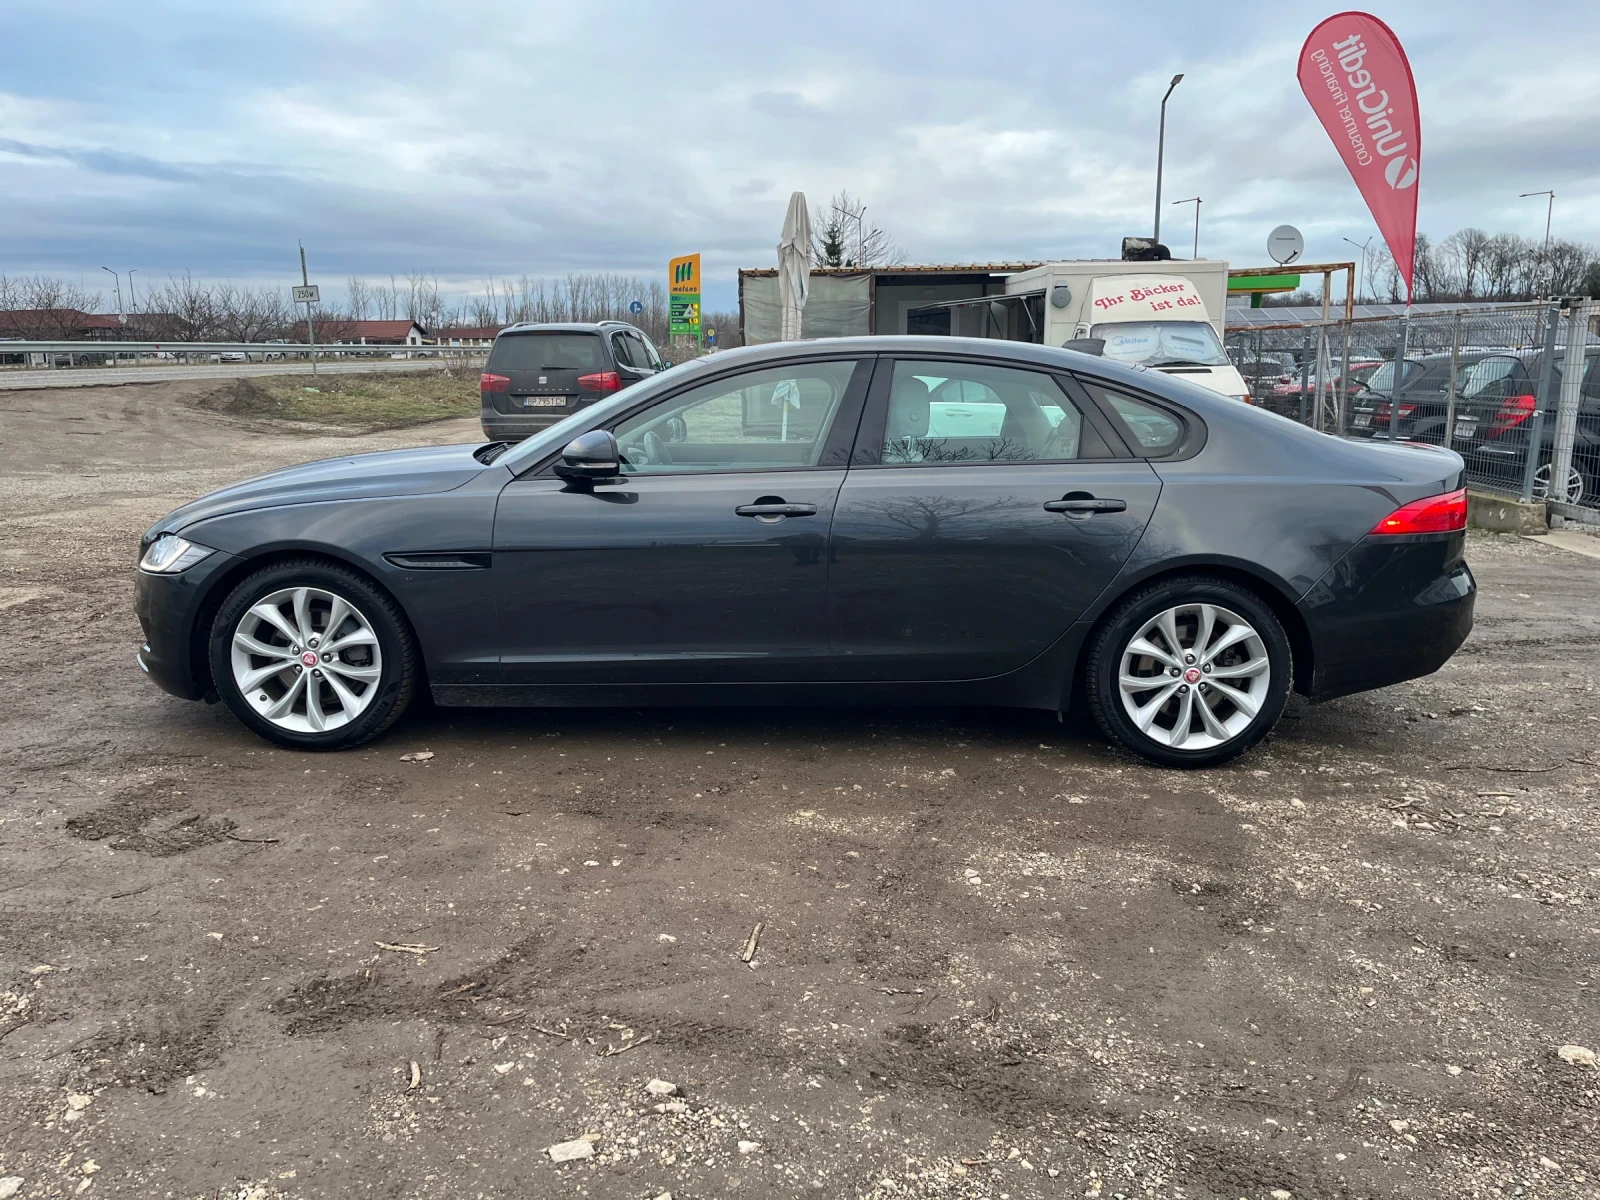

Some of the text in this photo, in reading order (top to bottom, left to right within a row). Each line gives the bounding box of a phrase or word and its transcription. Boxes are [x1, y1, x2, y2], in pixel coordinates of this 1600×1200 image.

[1094, 283, 1185, 310] Ihr Bäcker
[1149, 294, 1201, 312] ist da!
